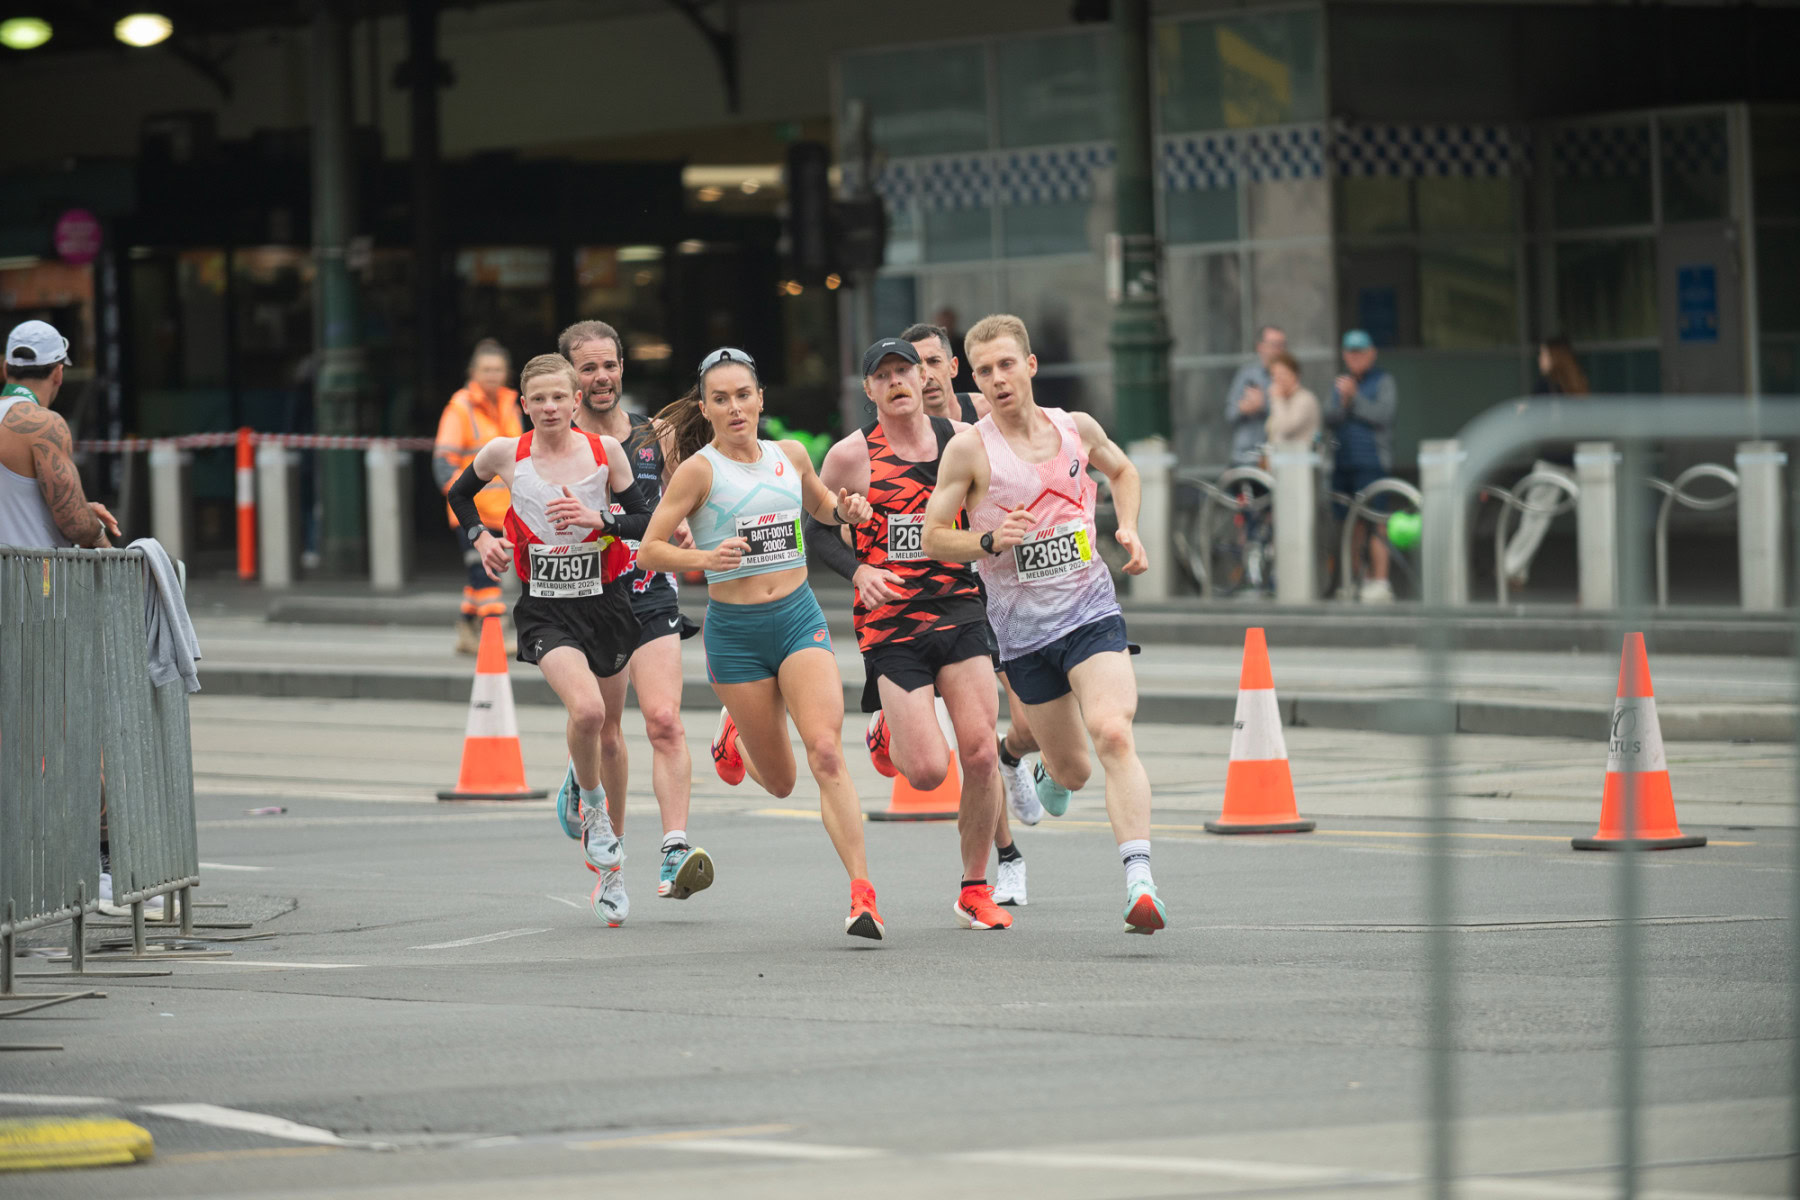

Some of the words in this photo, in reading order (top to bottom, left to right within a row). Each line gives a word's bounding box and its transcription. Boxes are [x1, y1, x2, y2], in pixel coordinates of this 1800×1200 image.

[751, 524, 794, 542] BATT-DOYLE
[895, 526, 922, 550] 26
[762, 538, 787, 553] 20002
[1022, 536, 1081, 570] 23693
[746, 552, 785, 565] MELBOURNE
[537, 554, 593, 581] 27597
[1026, 564, 1067, 579] MELBOURNE
[536, 582, 577, 590] MELBOURNE
[578, 581, 595, 589] 2025
[1609, 740, 1641, 753] LTUS
